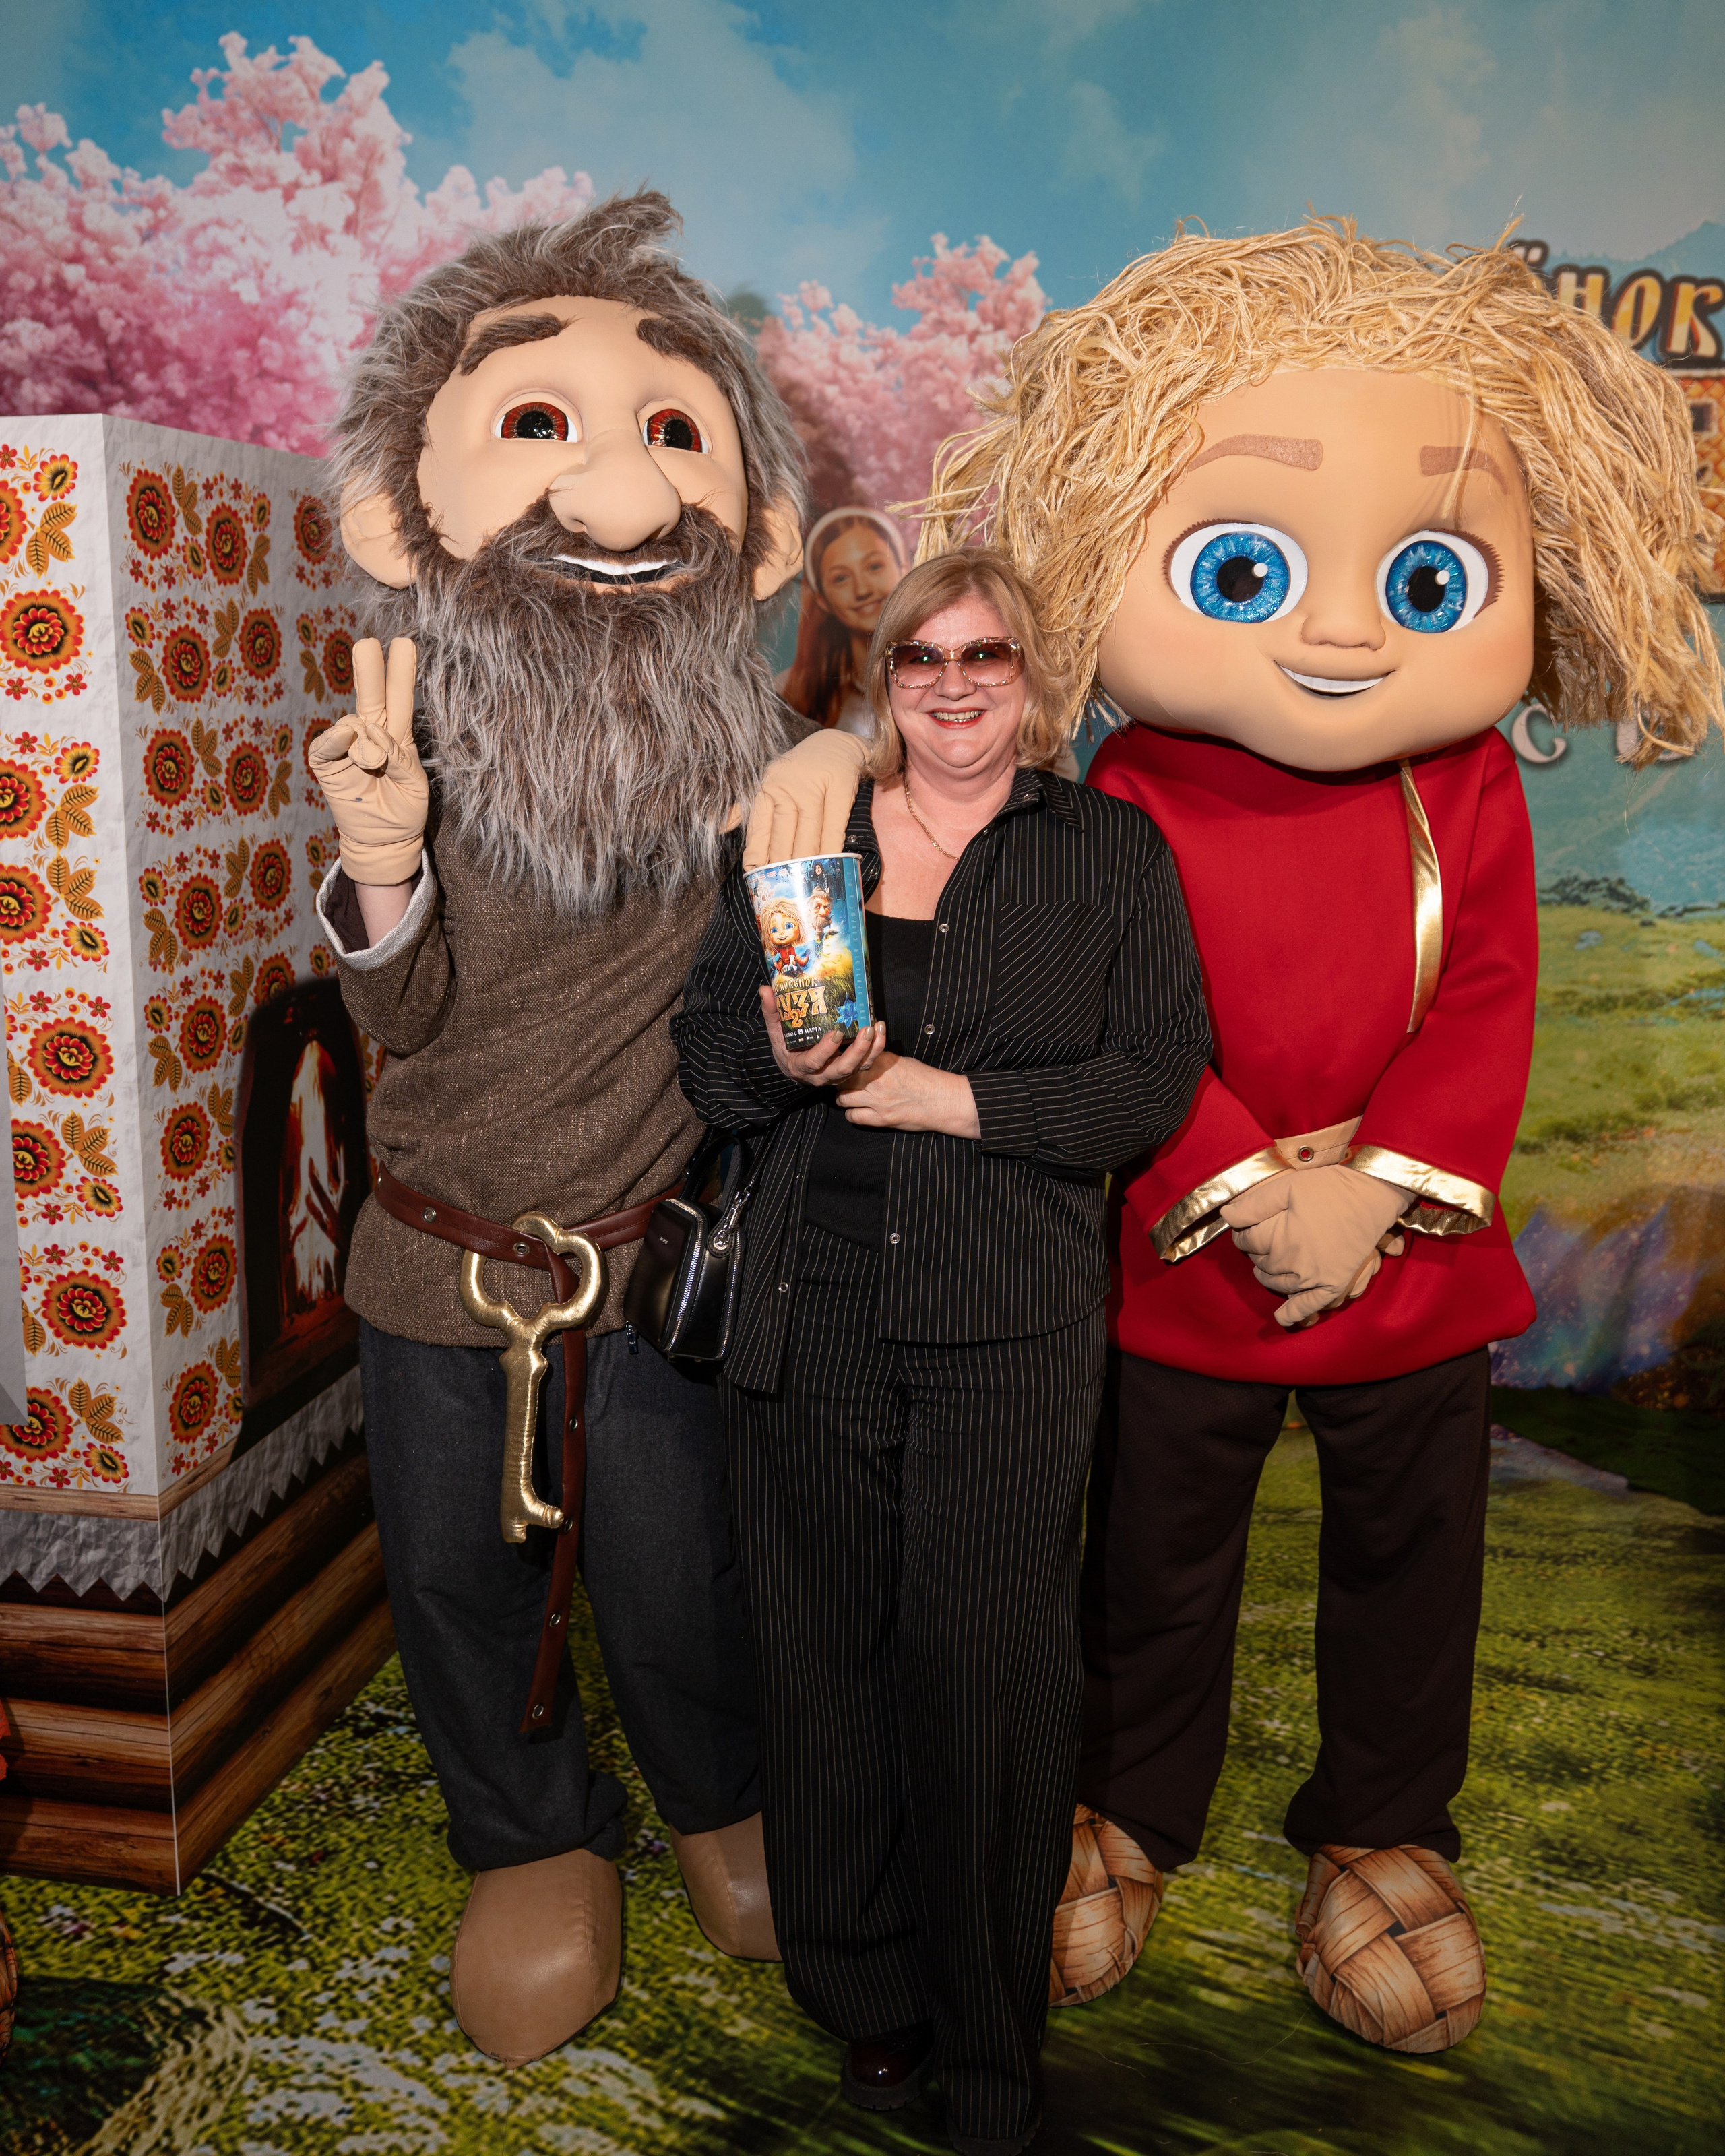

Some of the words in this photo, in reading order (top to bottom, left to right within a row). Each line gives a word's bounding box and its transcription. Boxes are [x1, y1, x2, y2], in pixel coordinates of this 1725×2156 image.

[1515, 245, 1724, 358] НОК
[853, 949, 862, 995] ЗРИТЕЛЕЙ
[790, 1009, 803, 1029] 2
[804, 1026, 822, 1034] МАРТА
